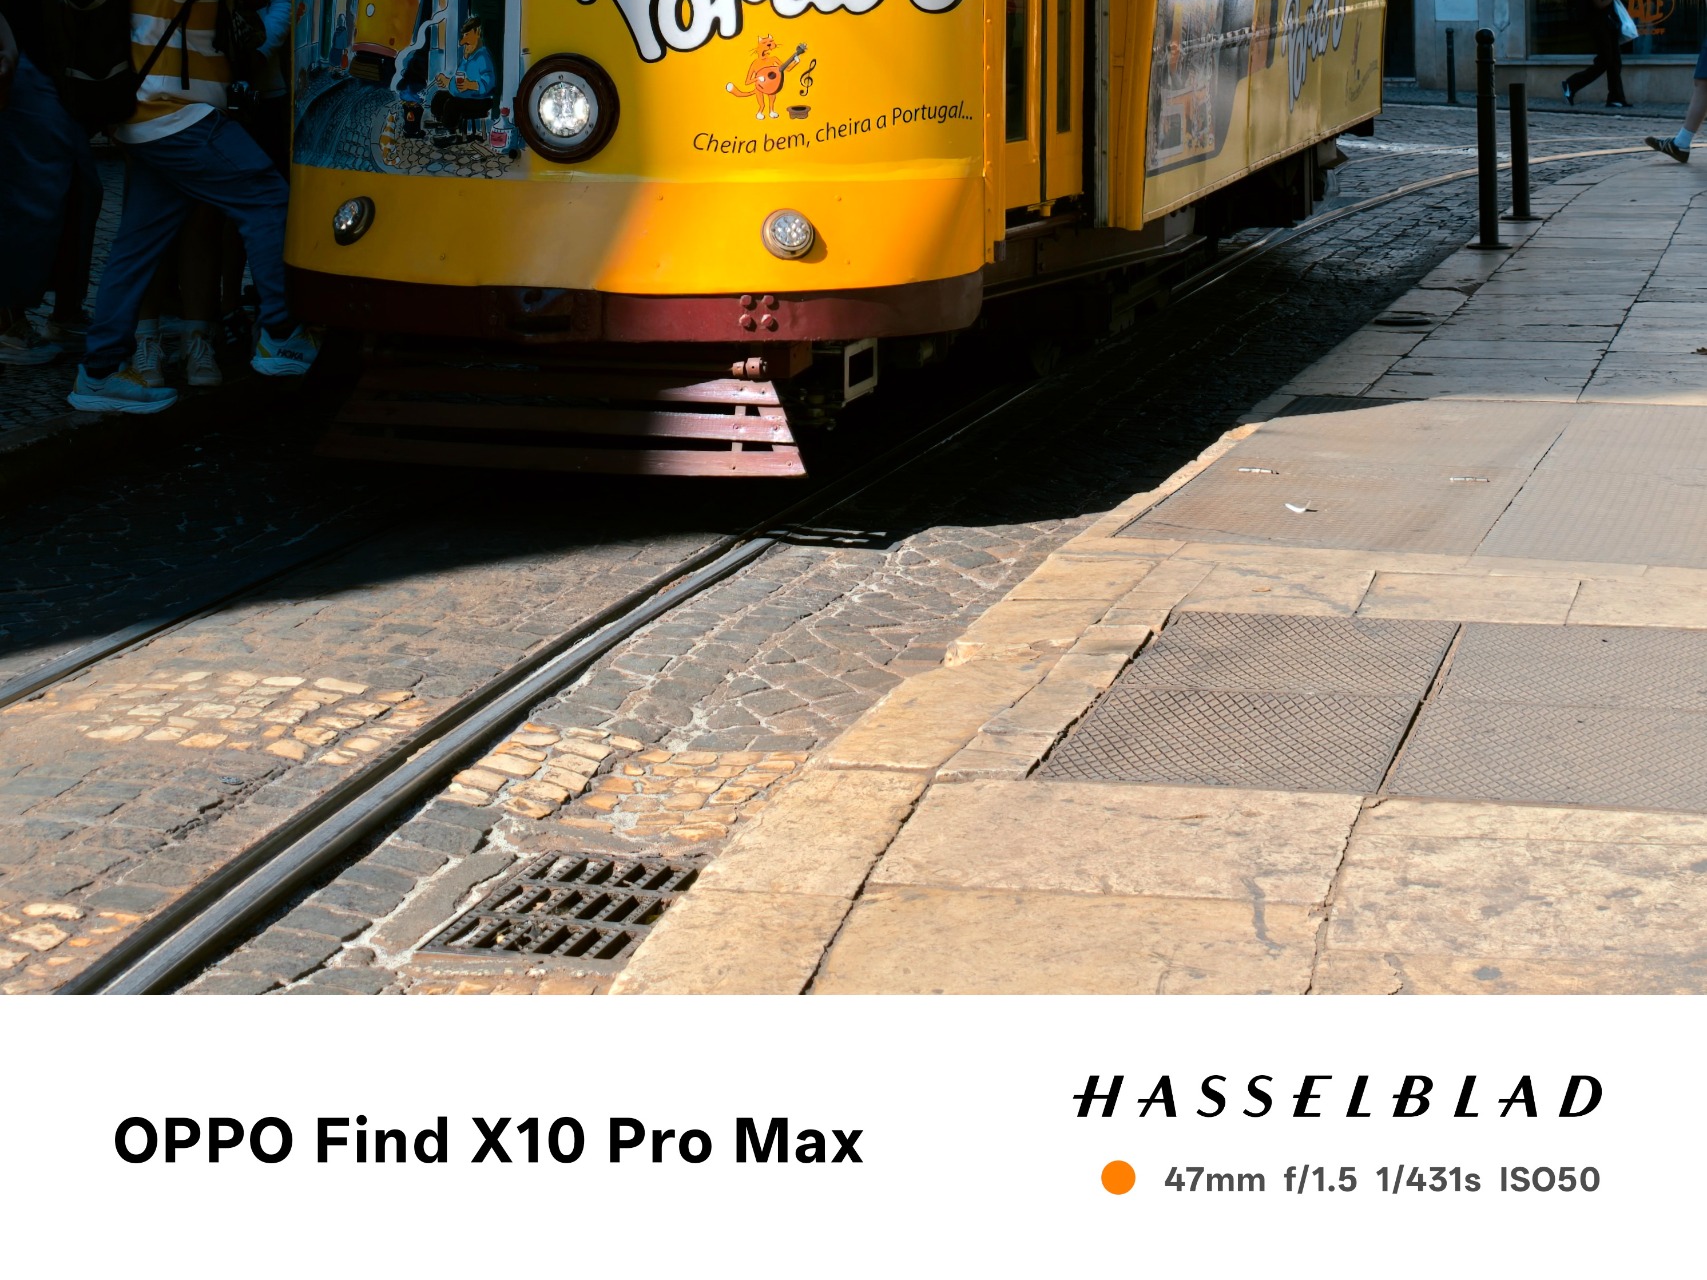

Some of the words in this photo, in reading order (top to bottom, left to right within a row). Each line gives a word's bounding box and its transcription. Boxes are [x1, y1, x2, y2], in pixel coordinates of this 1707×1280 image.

[693, 132, 757, 154] Cheira
[763, 132, 810, 152] bem,
[815, 118, 871, 143] cheira
[876, 114, 887, 129] a
[892, 100, 973, 125] Portugal...
[277, 348, 304, 360] HOKA
